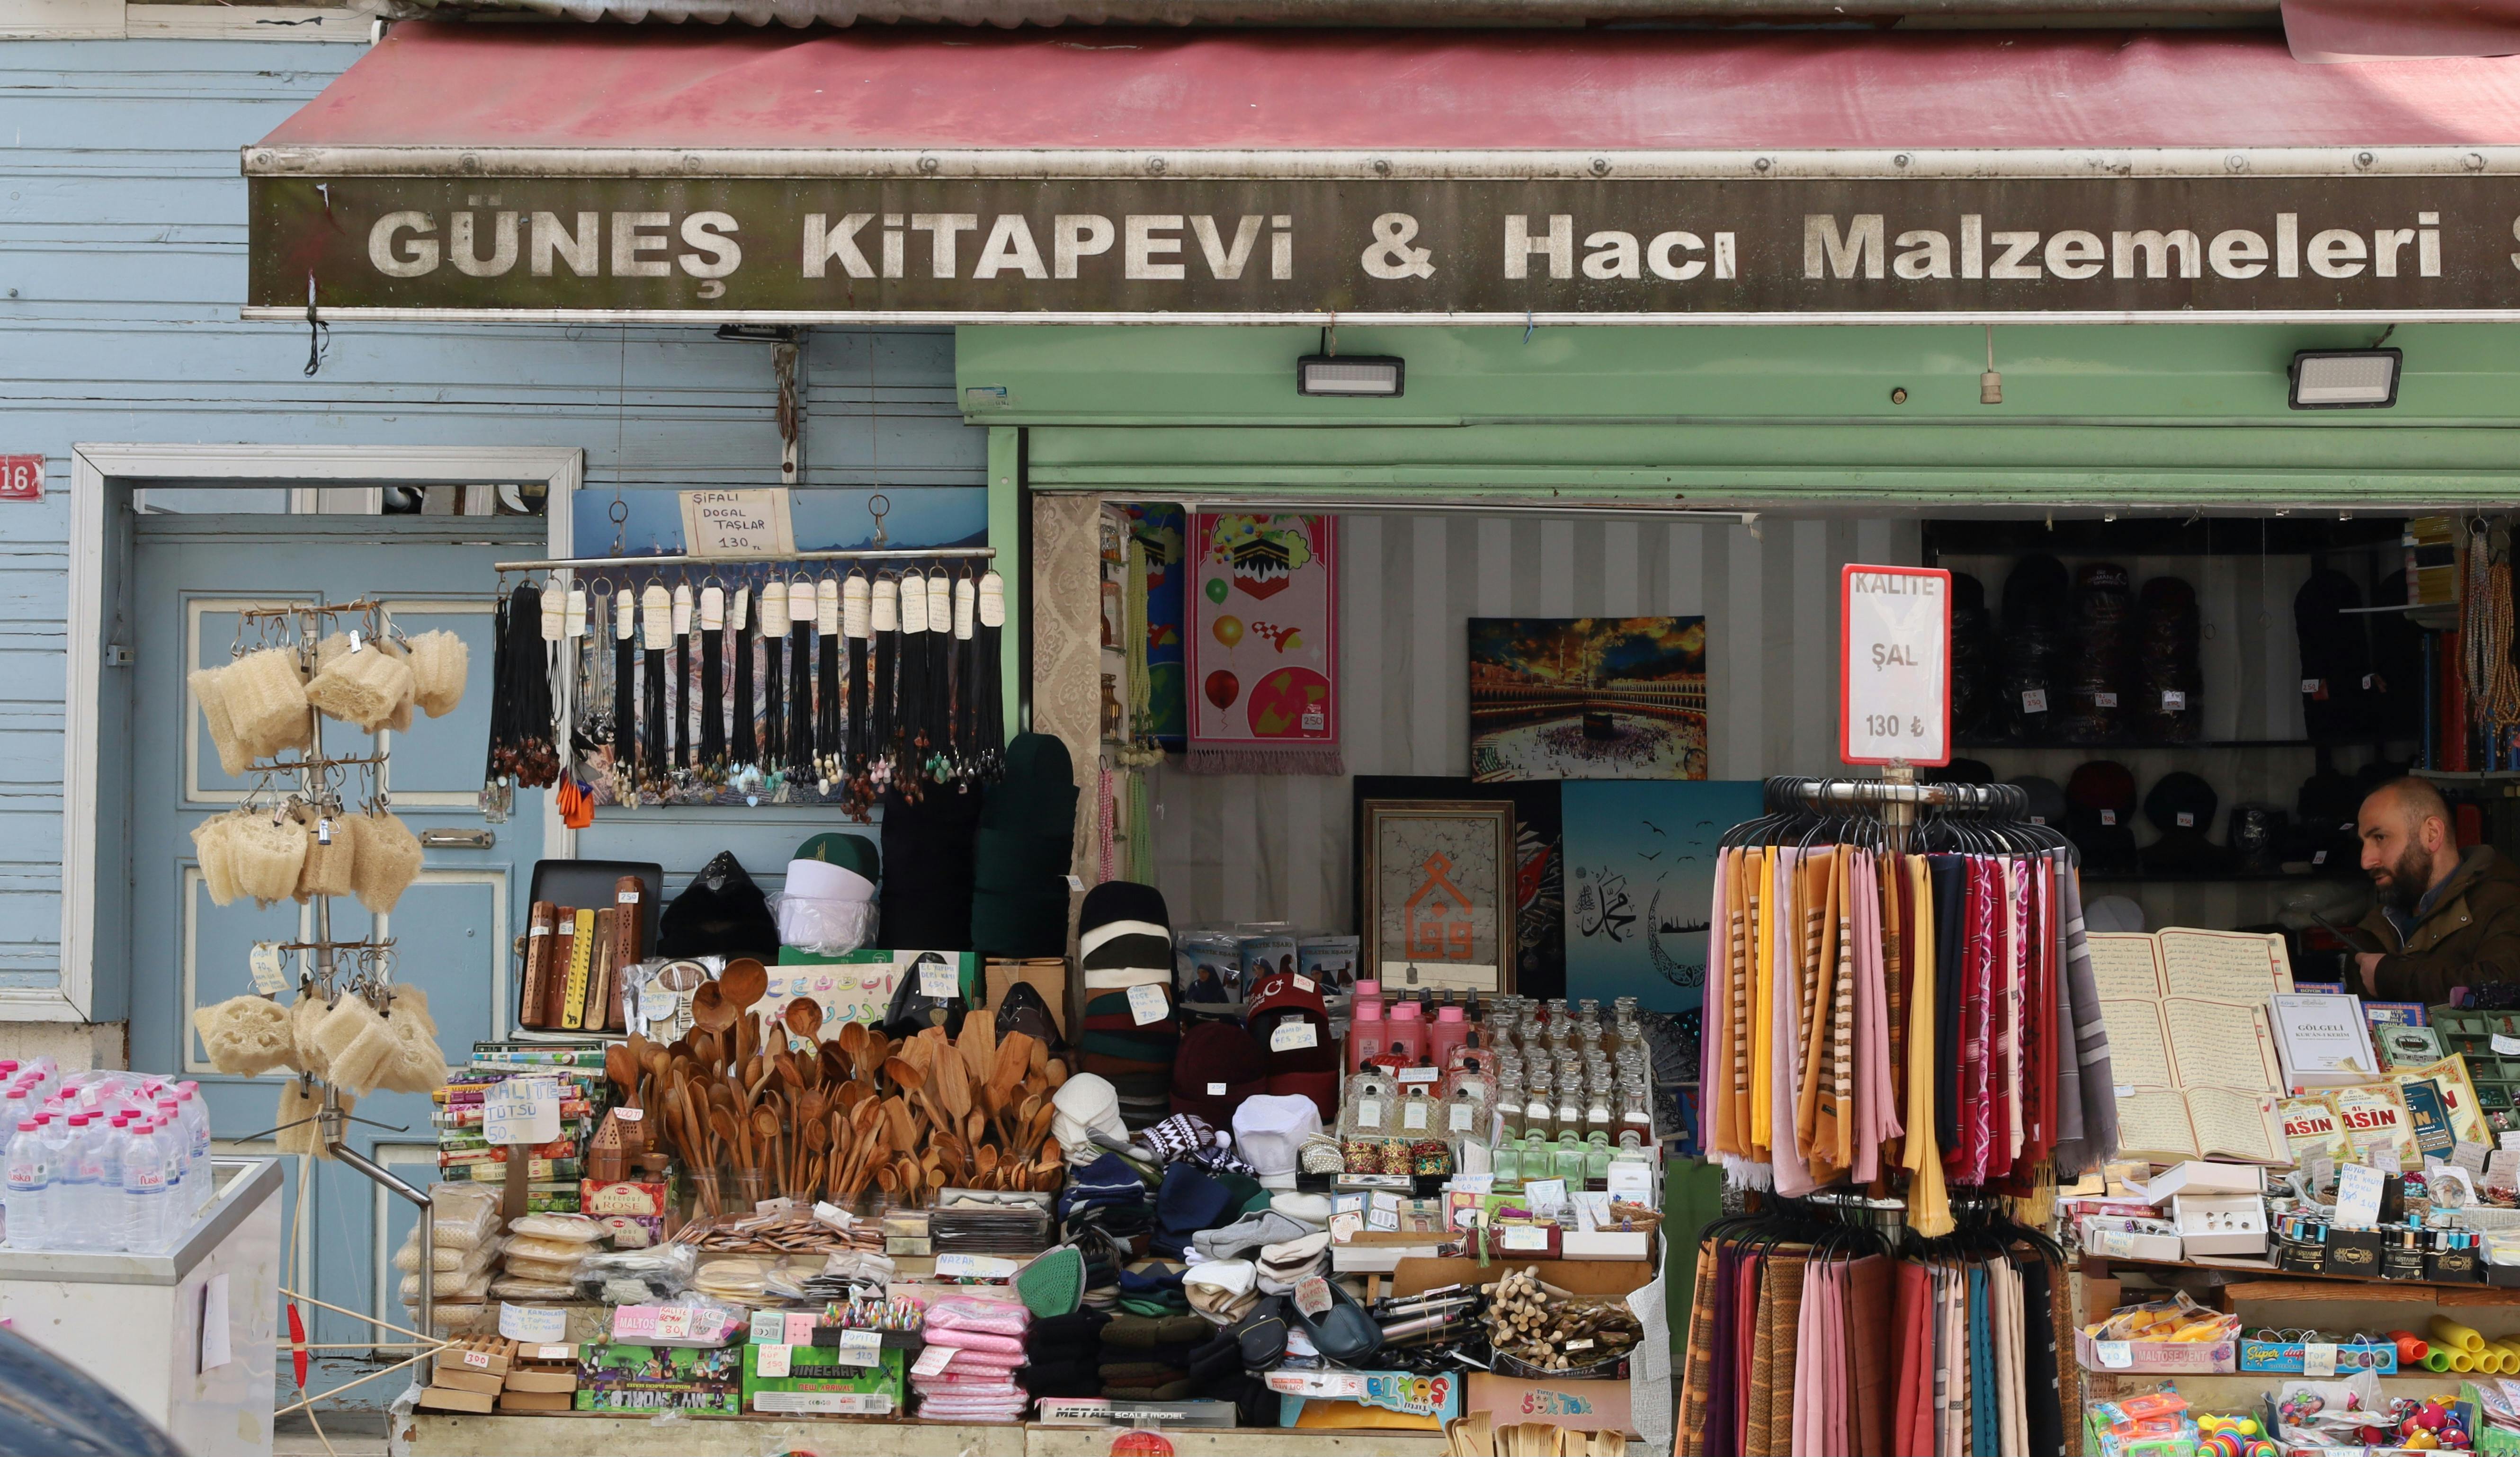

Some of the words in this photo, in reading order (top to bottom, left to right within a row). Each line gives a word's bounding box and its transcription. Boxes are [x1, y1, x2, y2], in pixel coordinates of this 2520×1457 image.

[368, 195, 742, 299] GÜNEŞ
[1361, 213, 1437, 280] &
[1504, 215, 1736, 280] Hacı
[1804, 211, 2441, 280] Malzemeleri
[1, 466, 28, 491] 16
[693, 492, 738, 505] ŞİFALI
[714, 519, 765, 530] TAŞLAR
[718, 537, 748, 548] 130
[1872, 643, 1918, 671] ŞAL
[1304, 717, 1323, 725] 250
[1866, 715, 1899, 737] 130
[1296, 978, 1311, 987] 150
[2298, 1023, 2344, 1031] GÖLGELİ
[1296, 1034, 1312, 1042] 250
[485, 1080, 560, 1102] KALİTE
[485, 1102, 536, 1121] TÜTSÜ
[617, 1108, 633, 1117] 200
[2341, 1108, 2397, 1129] ÂSÎN
[488, 1125, 507, 1142] 50
[140, 1175, 163, 1185] fuska
[603, 1202, 640, 1210] ROSE
[940, 1255, 974, 1266] NAZAR
[1305, 1301, 1320, 1312] 600
[619, 1317, 658, 1330] MALTOS
[665, 1325, 680, 1334] 80
[855, 1351, 872, 1360] 120
[2283, 1347, 2305, 1360] dup
[466, 1354, 486, 1365] 300
[790, 1365, 867, 1379] MINECRAFT
[1272, 1382, 1289, 1390] MEST
[1367, 1377, 1398, 1407] Ta
[1557, 1392, 1593, 1415] Tak
[1055, 1407, 1110, 1418] METAL
